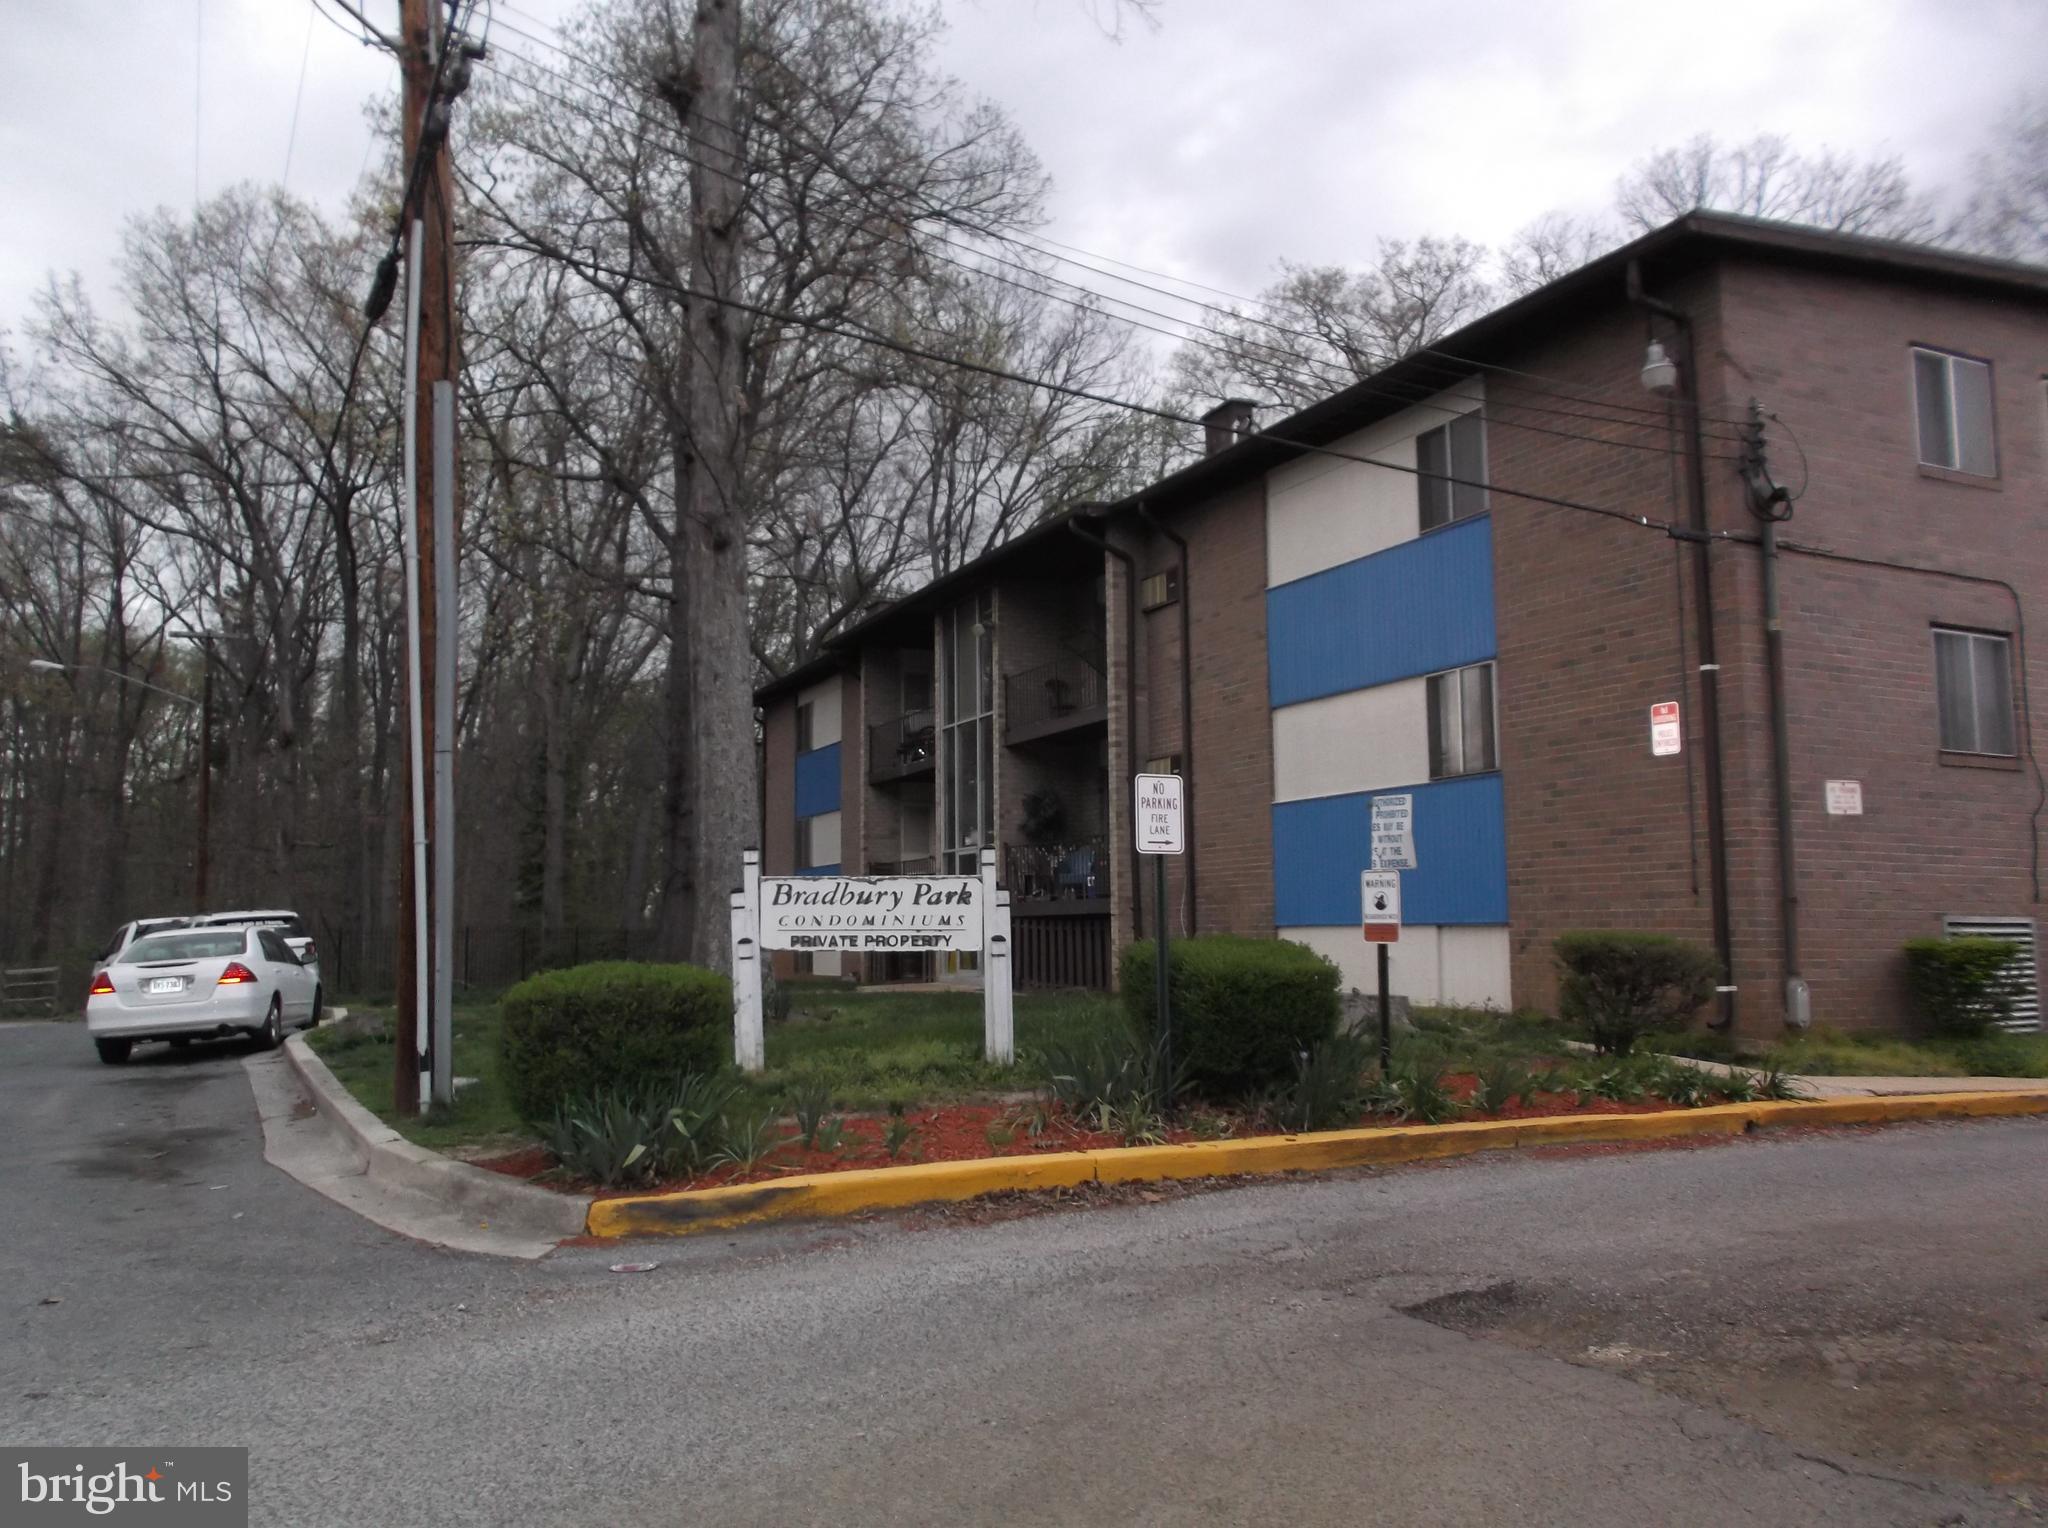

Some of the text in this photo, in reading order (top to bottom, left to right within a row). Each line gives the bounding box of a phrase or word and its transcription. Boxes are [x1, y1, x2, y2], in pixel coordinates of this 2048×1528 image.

[1152, 783, 1165, 795] NO
[1141, 797, 1178, 810] PARKING
[1151, 813, 1168, 823] FIRE
[1149, 825, 1170, 835] LANE
[1365, 879, 1396, 888] WARNING
[771, 881, 973, 912] Bradbury Park
[778, 914, 966, 927] CONDOMINIUMS
[790, 934, 952, 947] PRIVATE PROPERTY
